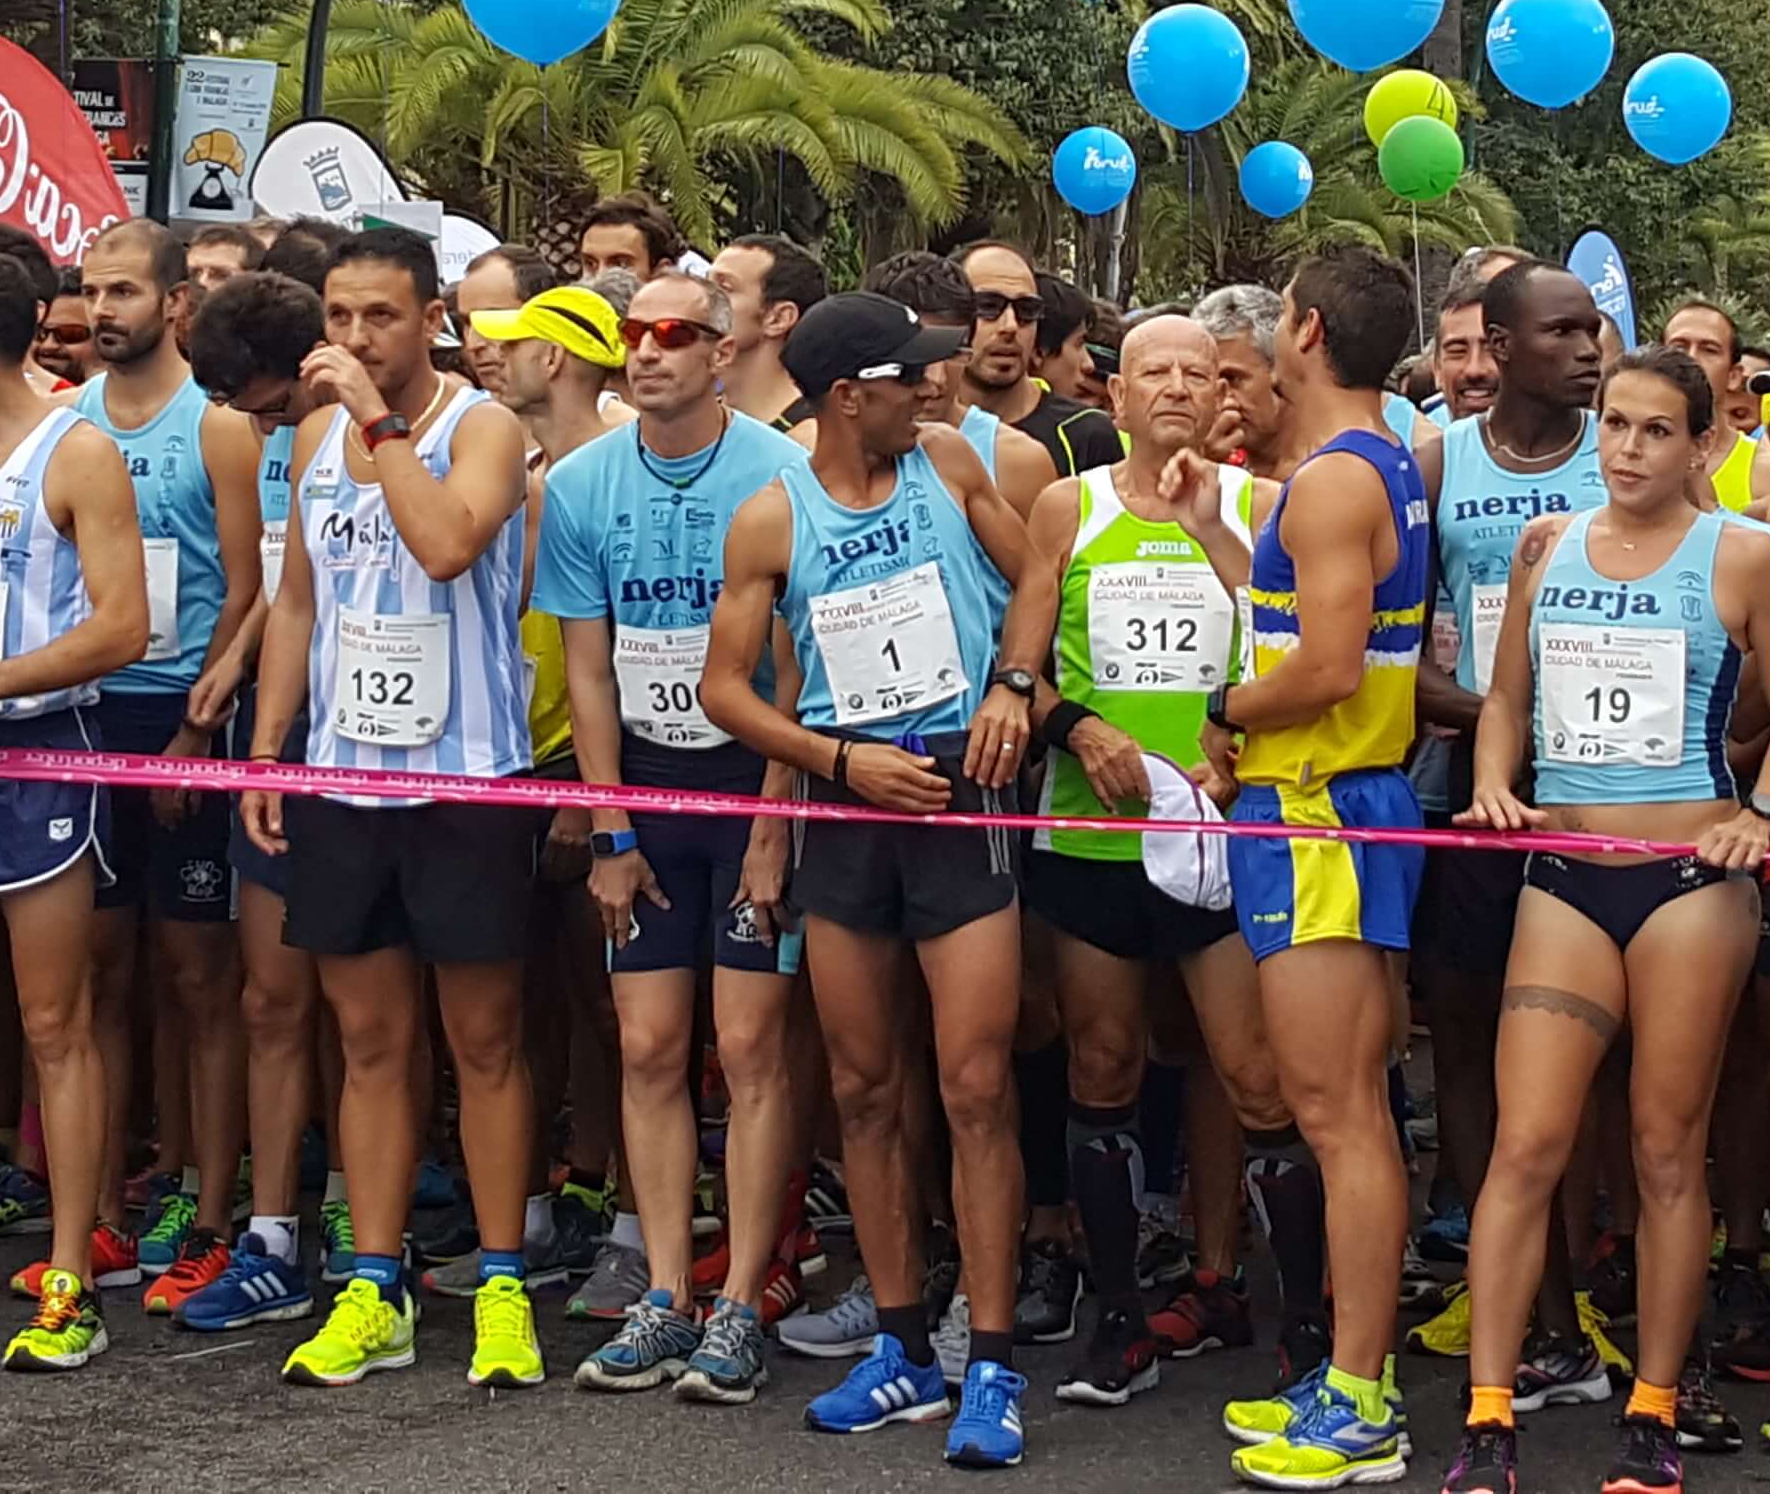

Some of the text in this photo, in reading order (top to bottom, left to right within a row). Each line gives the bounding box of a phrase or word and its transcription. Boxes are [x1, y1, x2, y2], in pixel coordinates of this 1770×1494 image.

[1454, 489, 1571, 522] nerja
[620, 568, 725, 609] nerja
[1540, 583, 1662, 621] nerja
[1125, 616, 1199, 653] 312
[879, 638, 902, 674] 1
[351, 668, 415, 706] 132
[648, 681, 701, 713] 30
[1584, 685, 1632, 724] 19
